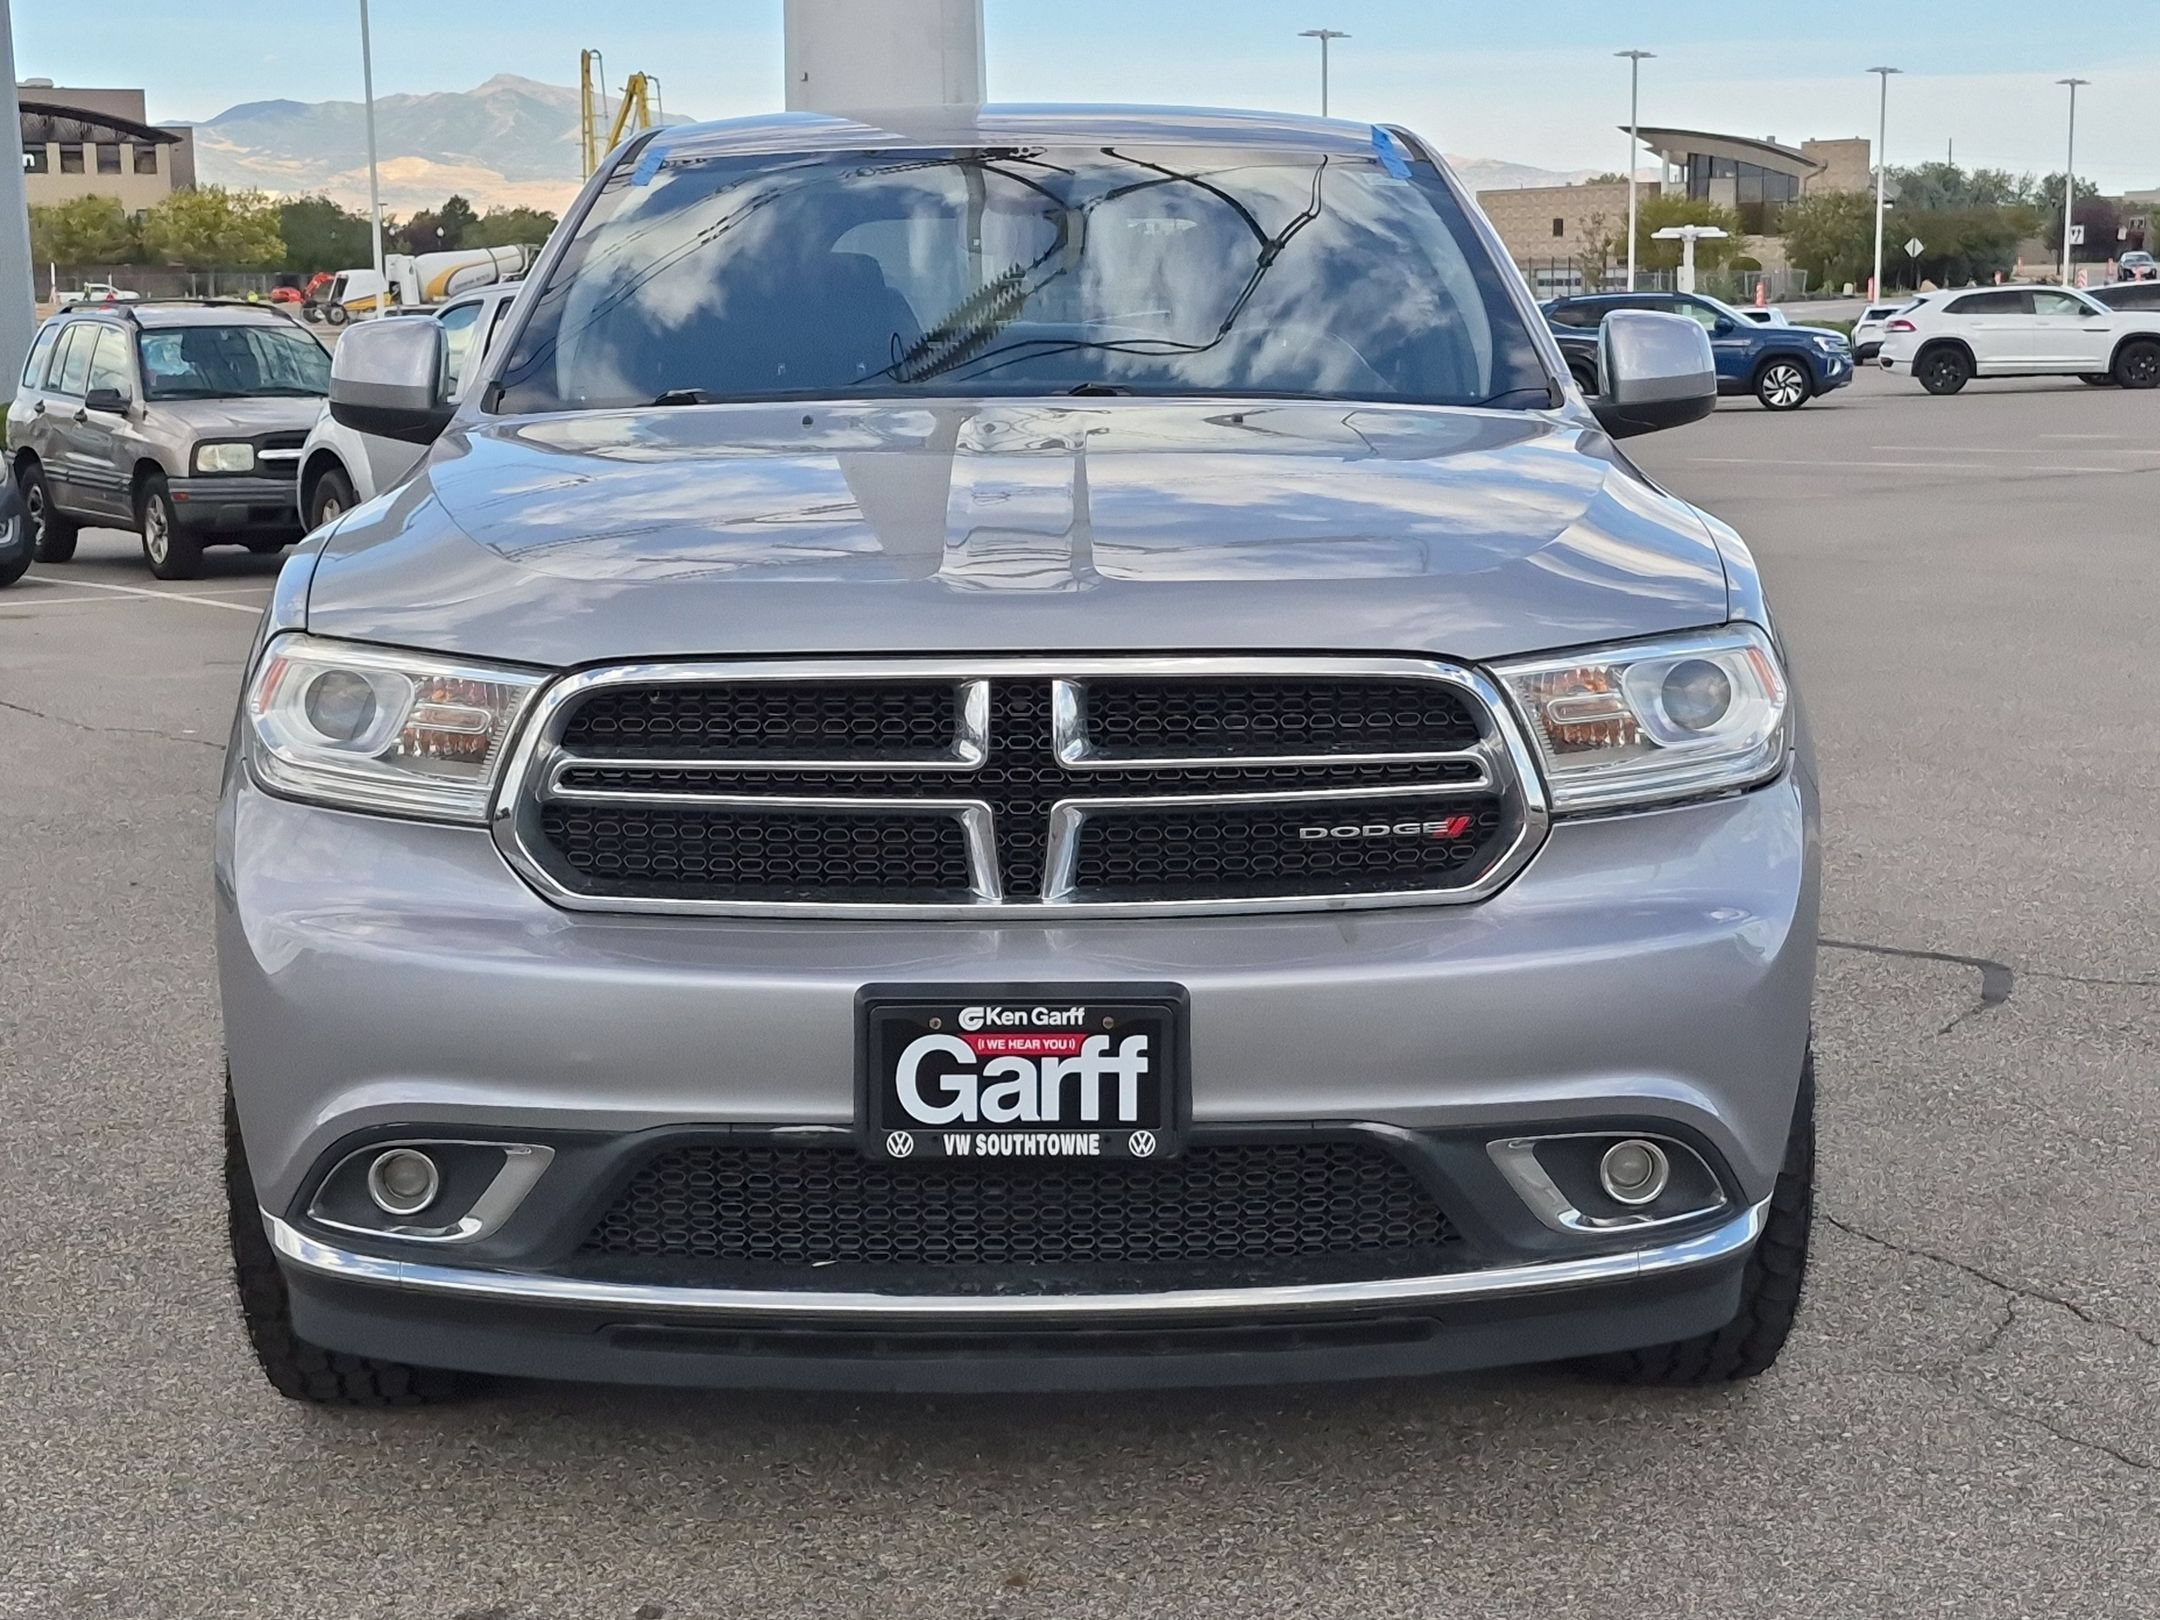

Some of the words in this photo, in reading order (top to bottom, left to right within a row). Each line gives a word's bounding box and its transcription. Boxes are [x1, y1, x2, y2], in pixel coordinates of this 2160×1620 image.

[1299, 821, 1449, 840] DODGE
[985, 1006, 1028, 1026] Ken
[1031, 1006, 1085, 1026] Garff
[987, 1039, 1006, 1050] WE
[1008, 1039, 1041, 1050] HEAR
[1043, 1039, 1068, 1050] YOU
[895, 1033, 1149, 1125] Garff
[943, 1133, 971, 1156] VW
[975, 1133, 1101, 1156] SOUTHTOWNE
